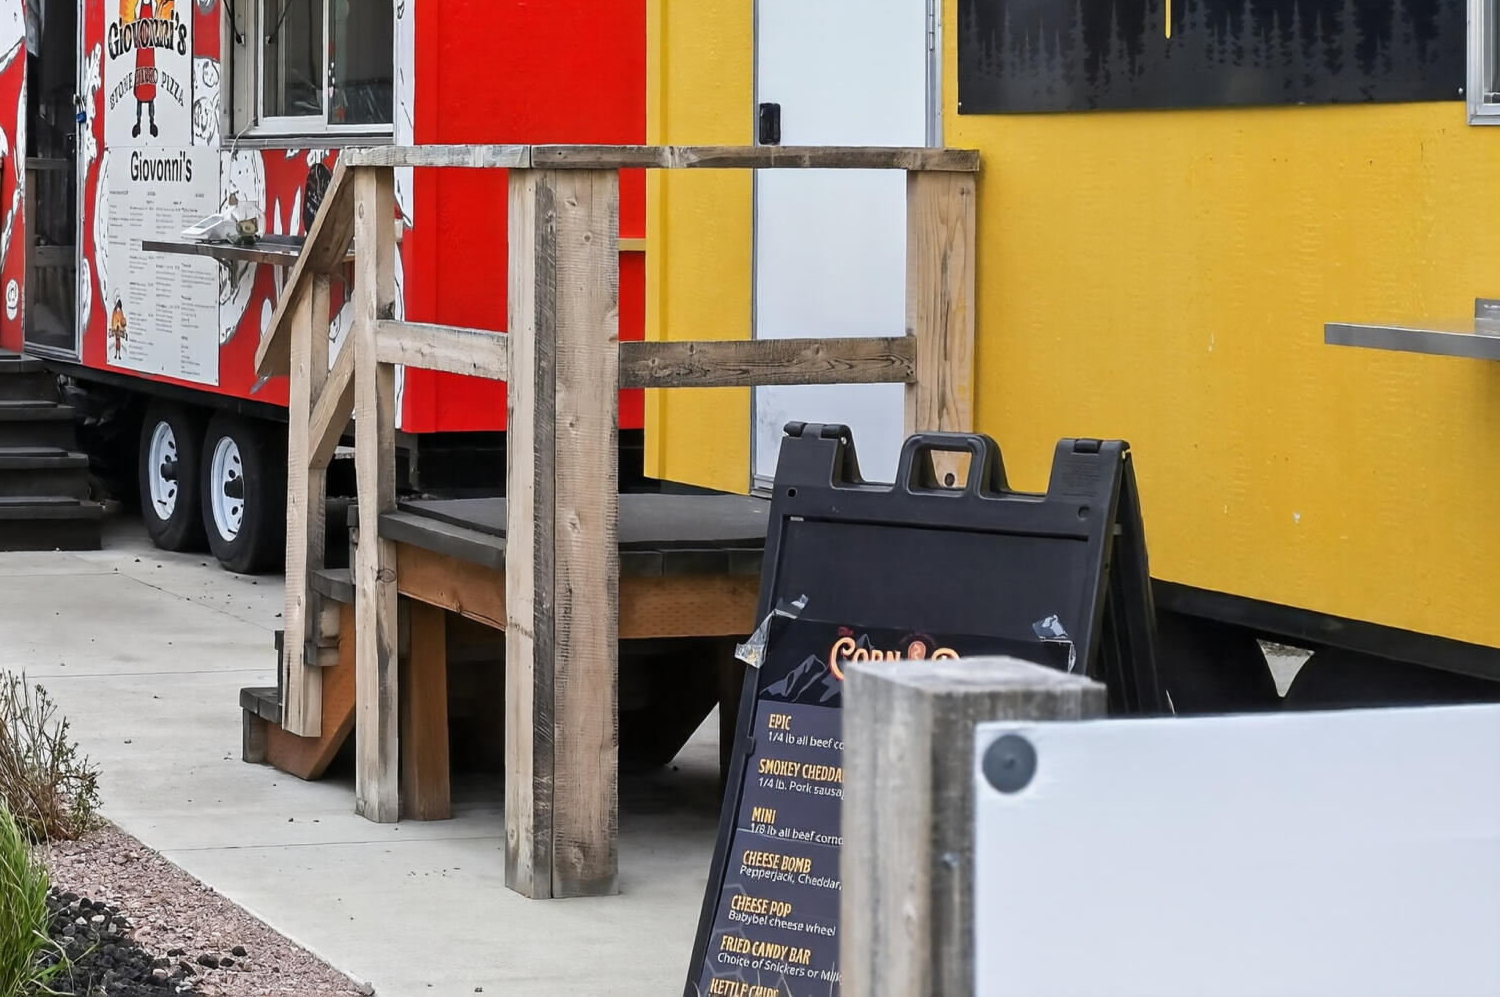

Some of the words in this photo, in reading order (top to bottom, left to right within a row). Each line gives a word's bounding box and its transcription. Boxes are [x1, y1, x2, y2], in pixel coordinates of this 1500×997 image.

[108, 10, 188, 60] Giovonni's
[109, 72, 133, 110] STONE
[161, 72, 185, 107] PIZZA
[130, 151, 192, 183] Giovonni's
[768, 713, 792, 730] EPIC
[768, 731, 784, 742] 1/4
[785, 733, 795, 744] lb
[796, 735, 808, 745] all
[810, 736, 834, 749] beef
[758, 758, 800, 777] SMOKEY
[802, 764, 844, 783] CHEDDA
[758, 777, 774, 788] 1/4
[775, 779, 787, 790] lb.
[789, 781, 812, 794] Pork
[751, 806, 776, 824] MINI
[750, 823, 765, 834] 1/8
[767, 825, 777, 835] lb
[778, 828, 791, 838] all
[792, 829, 816, 841] beef
[743, 850, 780, 869] CHEESE
[781, 855, 812, 874] BOMB
[739, 865, 795, 884] Pepperjack,
[731, 895, 769, 914] CHEESE
[770, 900, 792, 917] POP
[728, 910, 768, 925] Babybel
[769, 917, 804, 931] cheese
[805, 922, 836, 936] wheel
[720, 935, 751, 954] FRIED
[751, 941, 788, 961] CANDY
[789, 947, 811, 965] BAR
[717, 952, 750, 967] Choice
[751, 958, 763, 969] of
[764, 961, 805, 977] Snickers
[807, 969, 818, 978] or
